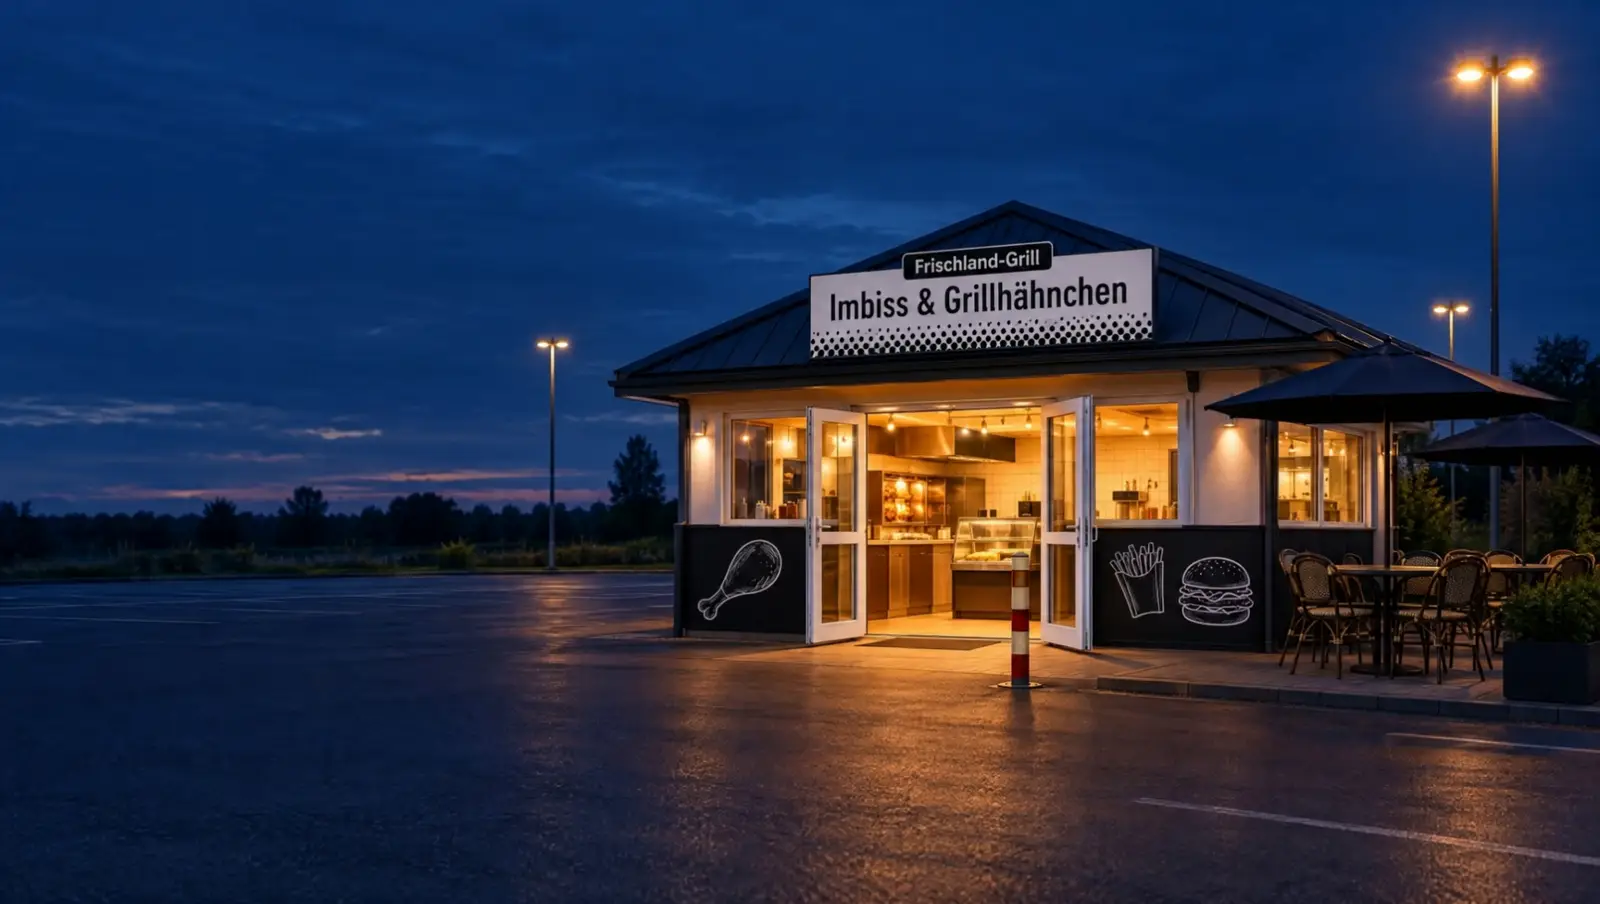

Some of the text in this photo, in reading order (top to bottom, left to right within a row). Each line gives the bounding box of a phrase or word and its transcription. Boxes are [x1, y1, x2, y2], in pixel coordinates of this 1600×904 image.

[915, 249, 1040, 274] Frischland-Grill
[830, 276, 1128, 321] Imbiss & Grillhähnchen
